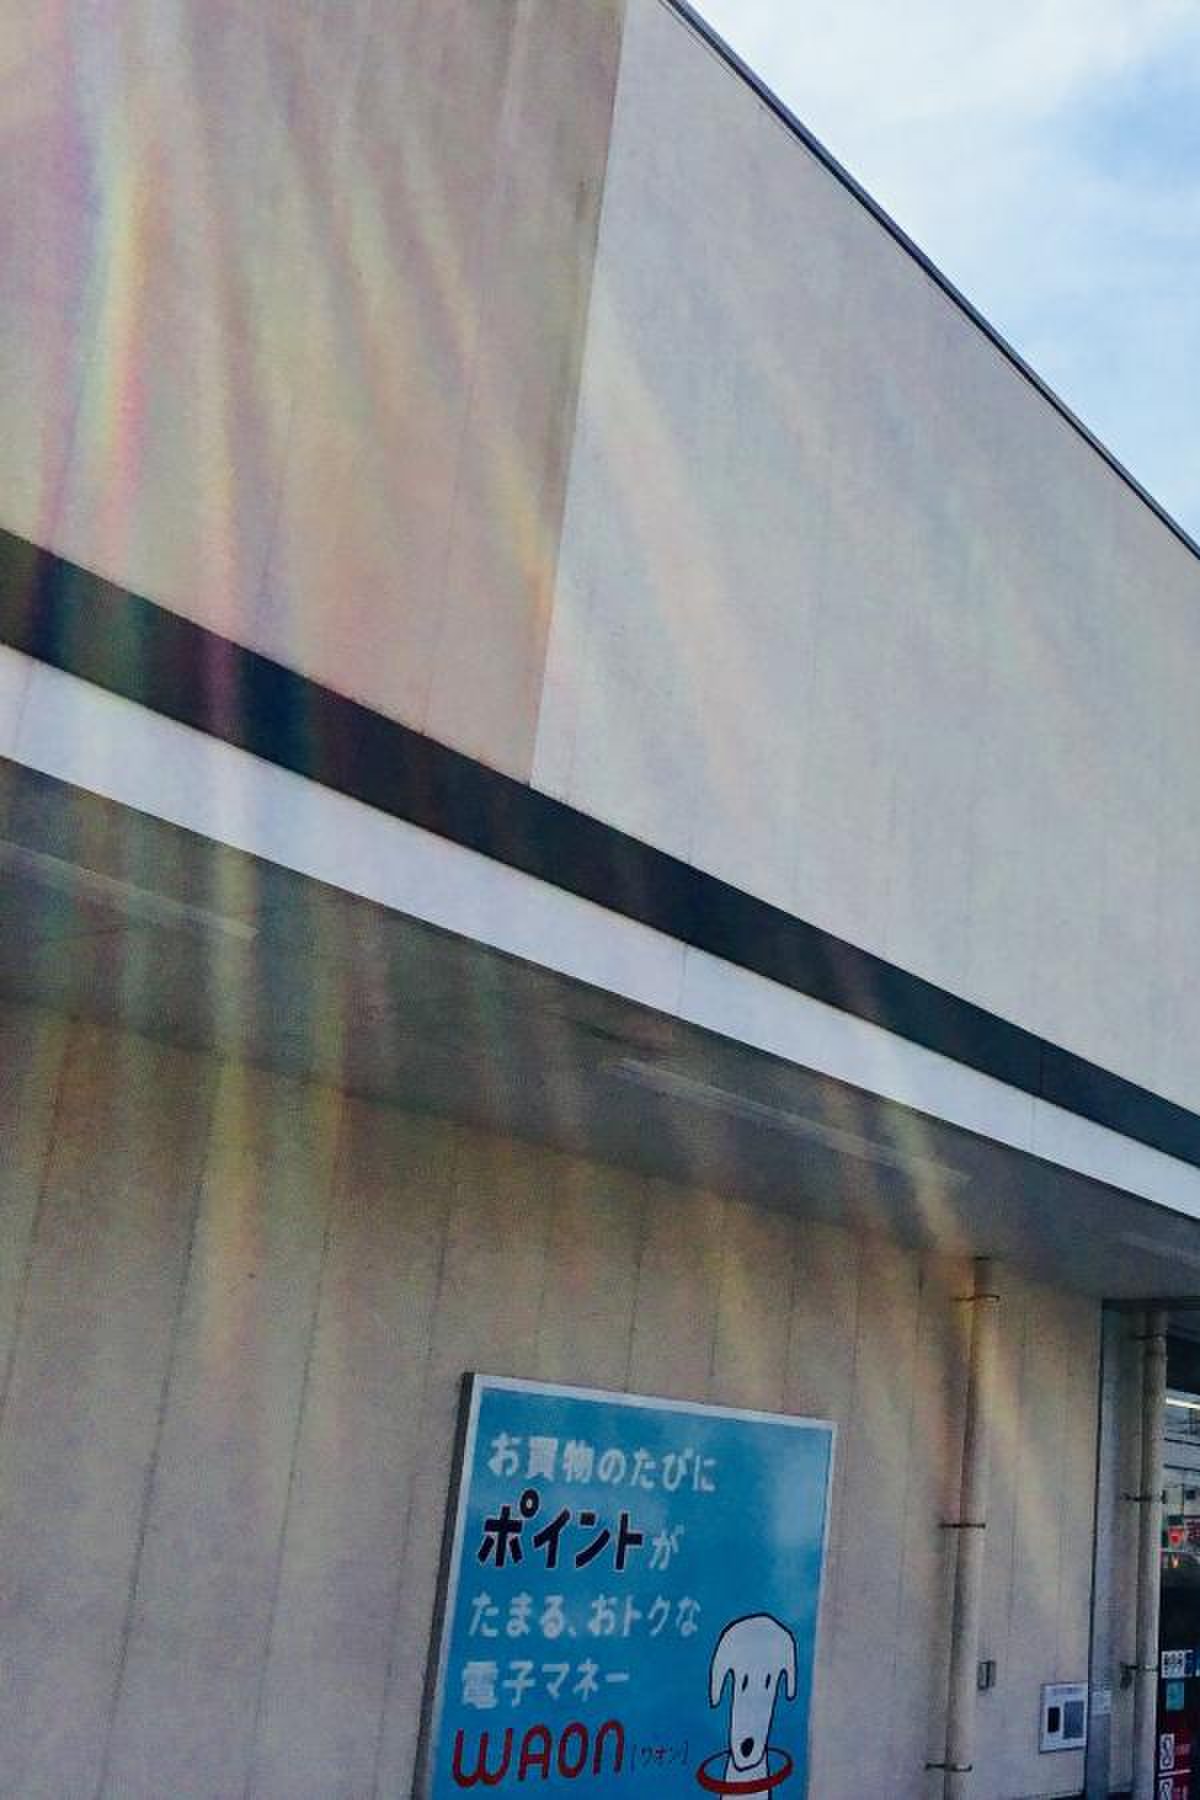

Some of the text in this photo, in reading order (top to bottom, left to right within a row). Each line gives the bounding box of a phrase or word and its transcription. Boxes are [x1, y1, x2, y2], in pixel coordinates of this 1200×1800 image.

[488, 1432, 717, 1492] お買物のたびに
[476, 1488, 685, 1570] ポイントが
[467, 1590, 701, 1639] たまる、おトクな
[460, 1658, 630, 1710] 電子マネー
[451, 1718, 626, 1790] WAON
